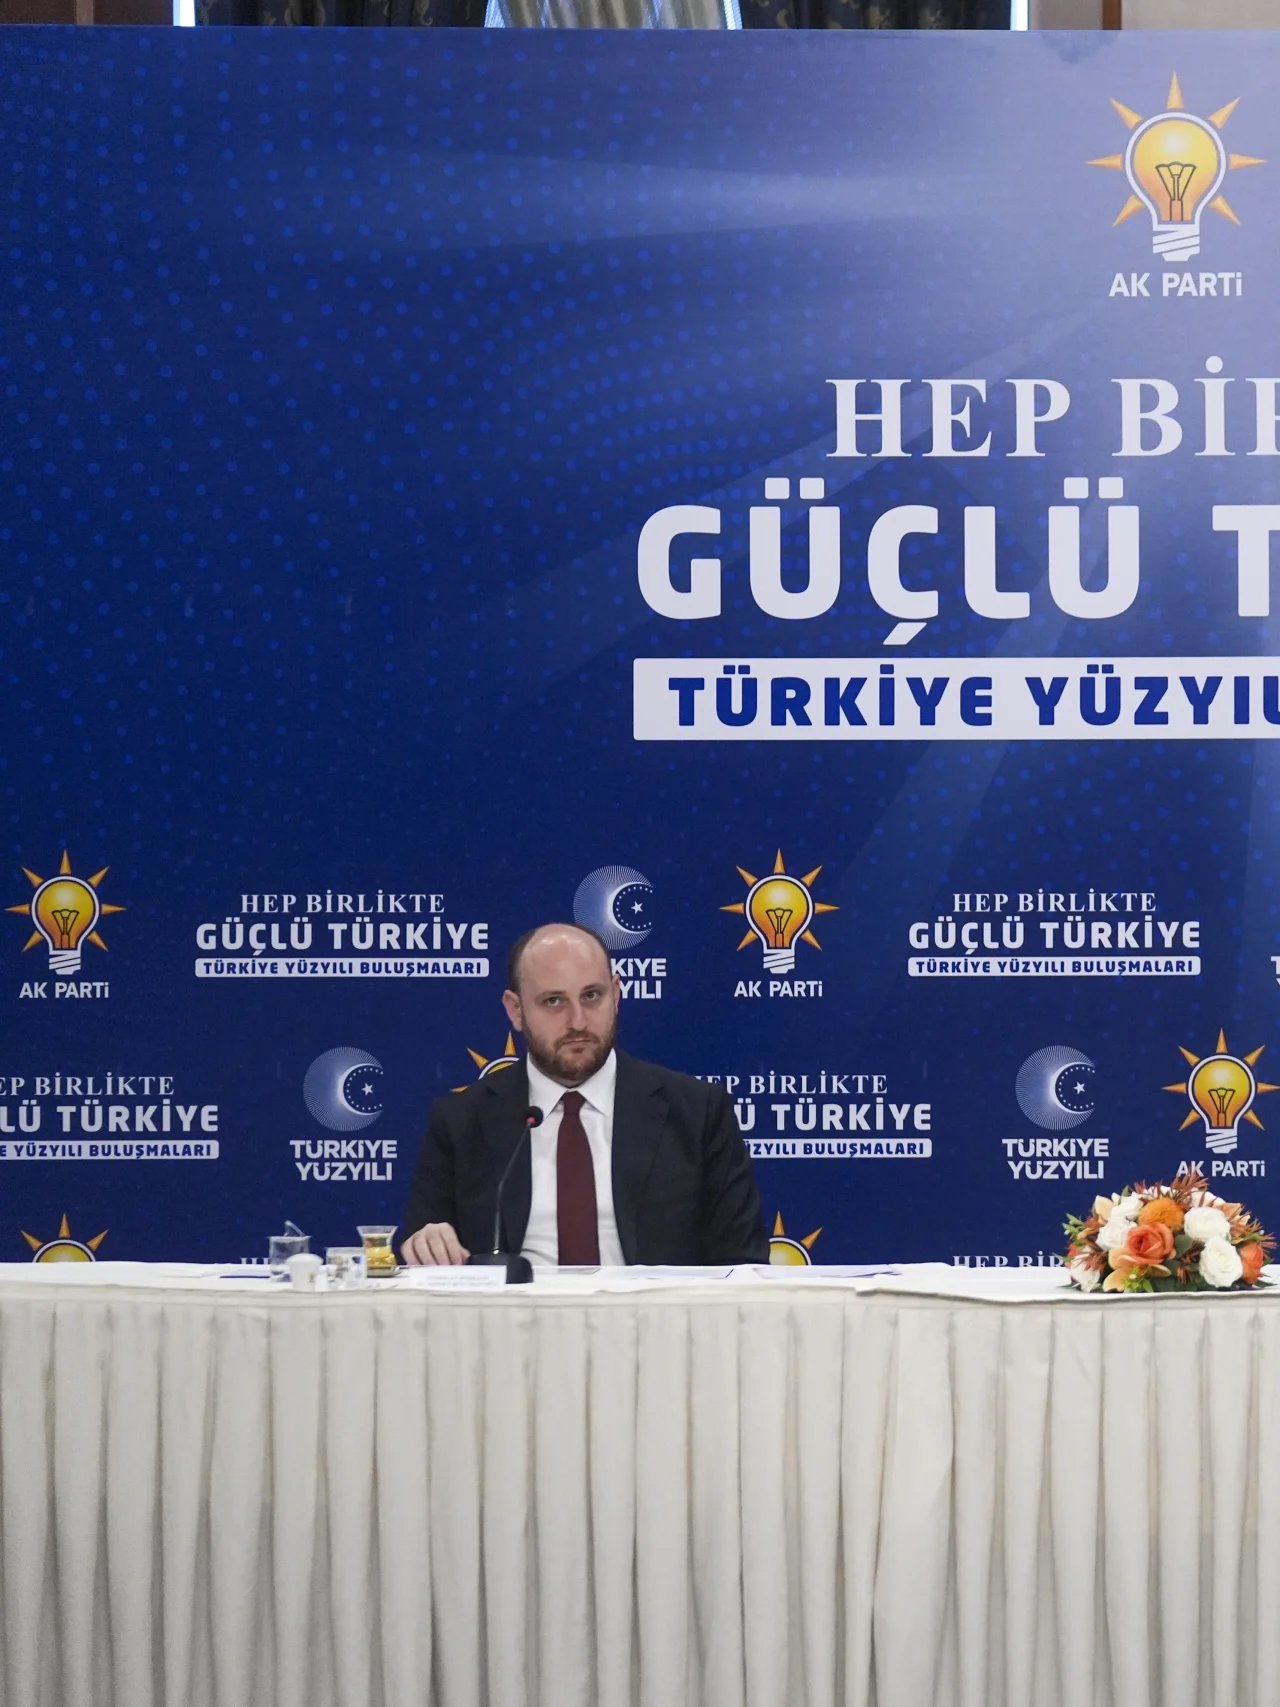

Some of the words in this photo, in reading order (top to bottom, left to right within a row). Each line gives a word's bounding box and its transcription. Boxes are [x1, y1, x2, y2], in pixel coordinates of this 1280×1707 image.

[1109, 273, 1150, 296] AK
[826, 379, 1070, 456] HEP
[638, 474, 1139, 645] GÜÇLÜ
[669, 664, 992, 726] TÜRKİYE
[242, 895, 296, 912] HEP
[307, 890, 444, 912] BİRLİKTE
[954, 894, 1008, 912] HEP
[1019, 889, 1155, 911] BİRLİKTE
[197, 917, 312, 955] GÜÇLÜ
[328, 917, 488, 949] TÜRKİYE
[909, 916, 1023, 954] GÜÇLÜ
[1040, 915, 1199, 948] TÜRKİYE
[204, 960, 277, 974] TÜRKİYE
[286, 960, 352, 974] YÜZYILI
[361, 962, 480, 977] BULUŞMALARI
[916, 959, 990, 973] TÜRKİYE
[998, 959, 1064, 972] YÜZYILI
[1072, 961, 1192, 975] BULUŞMALARI
[19, 982, 47, 998] AK
[734, 981, 761, 997] AK
[35, 1072, 173, 1095] BİRLİKTE
[750, 1071, 887, 1093] BİRLİKTE
[57, 1099, 218, 1132] TÜRKİYE
[771, 1097, 930, 1130] TÜRKİYE
[14, 1142, 81, 1157] YÜZYILI
[90, 1145, 210, 1159] BULUŞMALARI
[804, 1143, 923, 1157] BULUŞMALARI
[1175, 1160, 1205, 1177] AK
